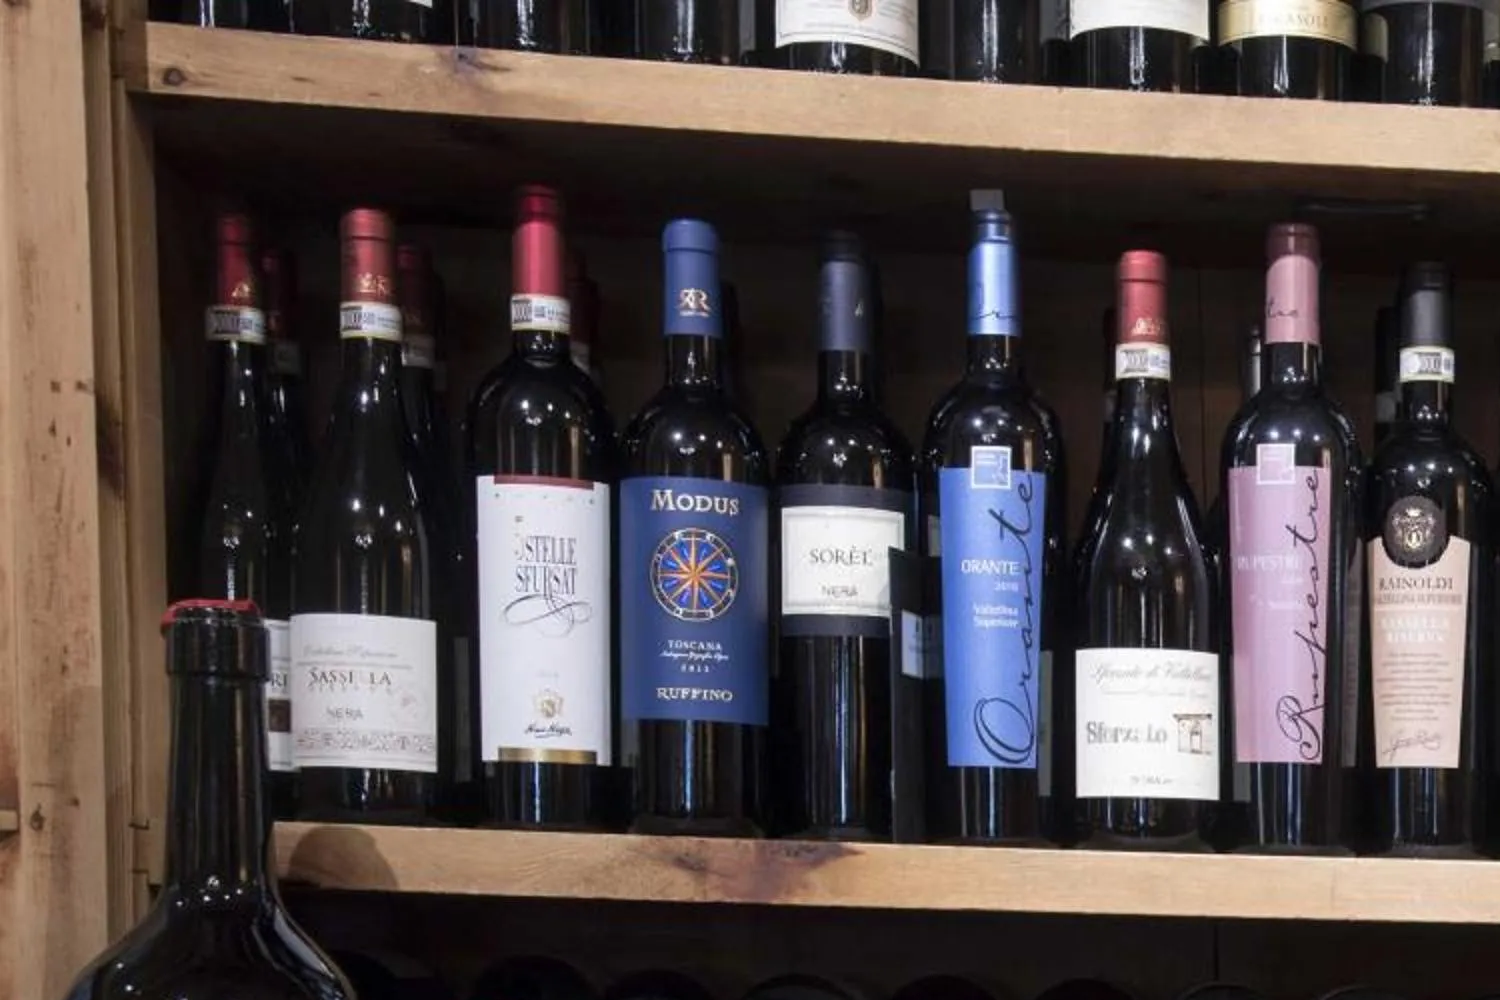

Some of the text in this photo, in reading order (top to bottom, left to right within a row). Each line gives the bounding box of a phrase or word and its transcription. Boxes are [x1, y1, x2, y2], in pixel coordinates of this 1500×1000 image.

[960, 558, 1021, 575] ORANTE
[1378, 575, 1454, 592] RAINOLDI
[667, 639, 723, 651] TOSCANA
[656, 686, 734, 703] RUFFINO
